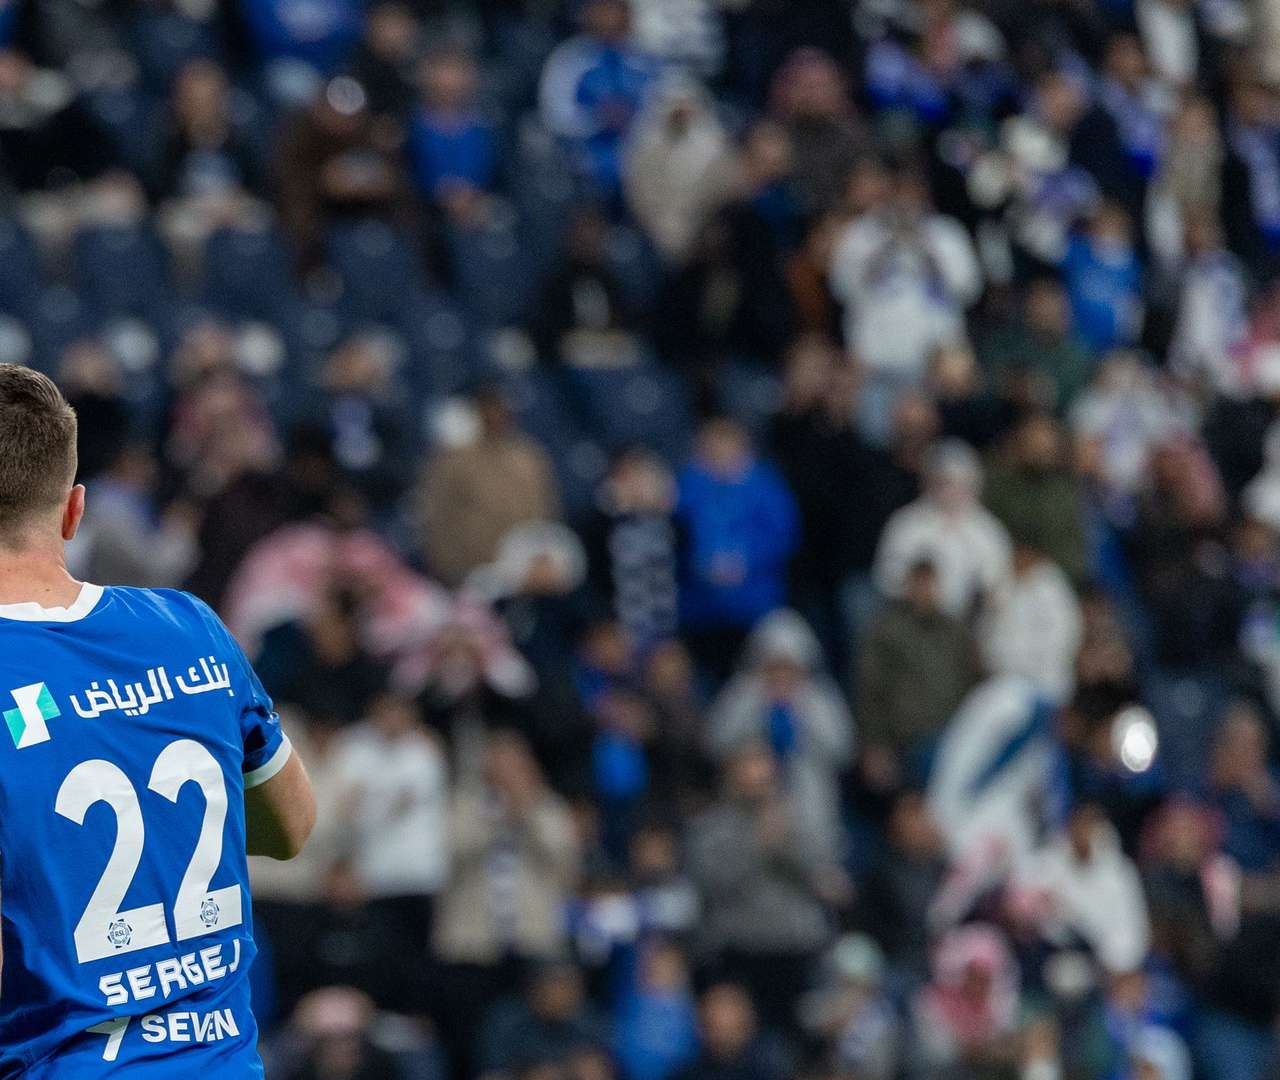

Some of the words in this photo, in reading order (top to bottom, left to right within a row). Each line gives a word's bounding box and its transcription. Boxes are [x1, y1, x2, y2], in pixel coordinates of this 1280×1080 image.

[69, 666, 174, 718] الرياض
[175, 656, 234, 696] بنك
[55, 739, 242, 964] 22
[99, 939, 240, 1006] SERGEJ
